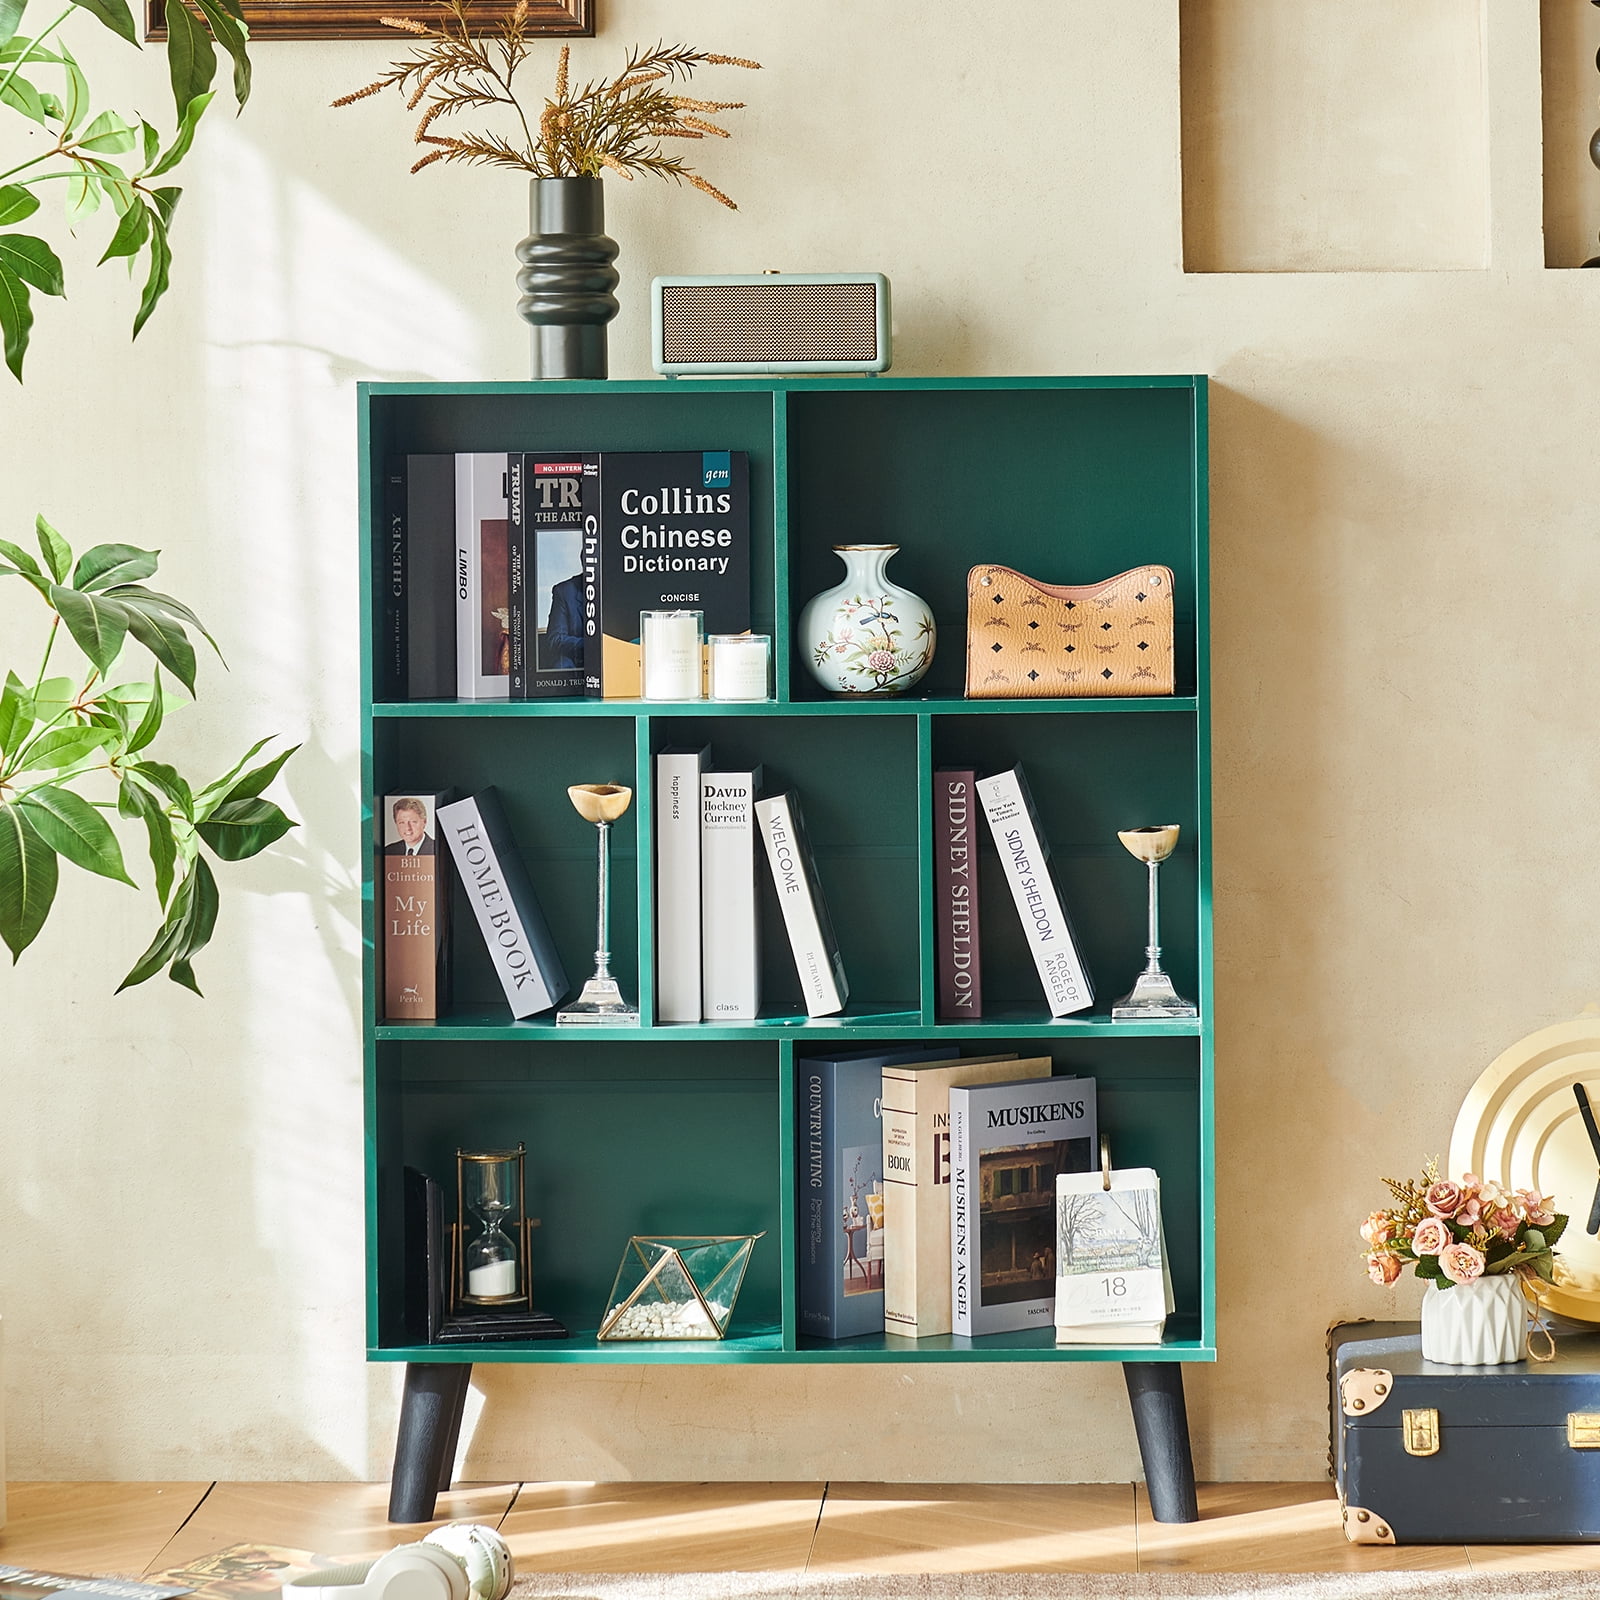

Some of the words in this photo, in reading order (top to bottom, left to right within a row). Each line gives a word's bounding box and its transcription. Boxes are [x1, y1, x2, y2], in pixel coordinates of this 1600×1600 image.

[704, 469, 729, 483] gem
[511, 464, 521, 526] TRUMP
[535, 478, 582, 508] TR
[620, 488, 731, 515] Collins
[534, 512, 558, 522] THE
[560, 511, 582, 522] ART
[620, 525, 732, 549] Chinese
[392, 513, 402, 597] CHENEY
[623, 555, 729, 575] Dictionary
[459, 549, 468, 600] LIMBO
[585, 515, 598, 636] Chinese
[660, 593, 700, 602] CONCISE
[671, 775, 680, 820] happiness
[704, 800, 747, 813] Hockney
[704, 812, 747, 823] Current
[948, 782, 968, 879] SIDNEY
[401, 858, 421, 868] Bill
[770, 815, 800, 894] WELCOME
[387, 872, 434, 882] Clintion
[1004, 829, 1033, 875] SIDNEY
[1021, 877, 1055, 942] SHELDON
[395, 896, 427, 917] My
[457, 823, 504, 908] HOME
[489, 911, 535, 990] BOOK
[392, 920, 431, 936] Life
[951, 884, 973, 1008] SHELDON
[1044, 960, 1068, 1003] ANGELS
[1066, 986, 1080, 1001] OF
[716, 1003, 740, 1011] class
[809, 1075, 822, 1139] COUNTRY
[987, 1101, 1085, 1128] MUSIKENS
[810, 1140, 822, 1188] LIVING
[887, 1154, 911, 1172] BOOK
[955, 1167, 966, 1255] MUSIKENS
[957, 1259, 967, 1320] ANGEL
[1101, 1276, 1127, 1297] 18
[1027, 1307, 1050, 1315] TASCHEN
